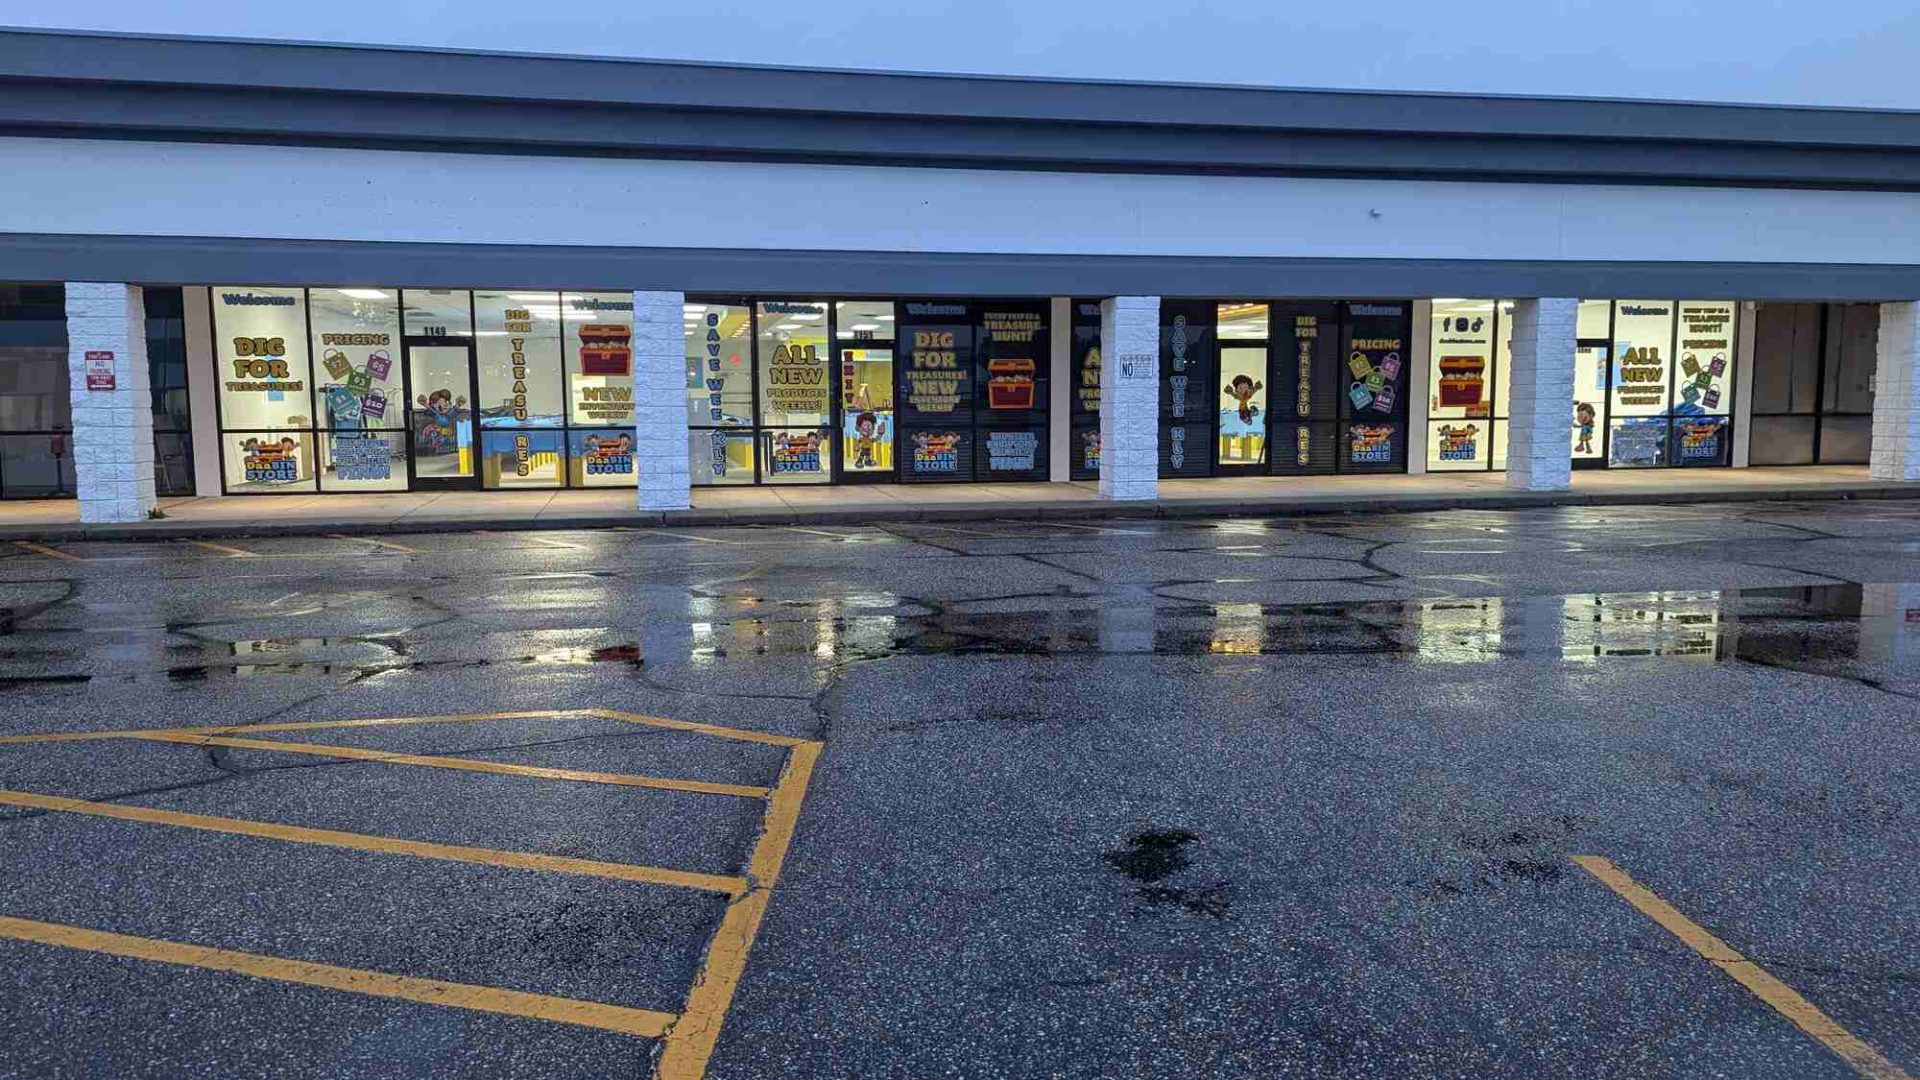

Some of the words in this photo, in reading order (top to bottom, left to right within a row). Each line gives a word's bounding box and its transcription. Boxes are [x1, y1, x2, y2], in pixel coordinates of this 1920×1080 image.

[222, 293, 295, 306] Welcome
[764, 301, 824, 314] Welcome
[1620, 305, 1669, 316] Welcome
[505, 309, 530, 320] DIG
[424, 326, 446, 337] 1149
[505, 322, 531, 333] FOR
[983, 320, 1041, 330] TREASURE
[1296, 327, 1317, 338] FOR
[322, 333, 390, 346] PRICING
[706, 313, 721, 372] SAVE
[914, 332, 954, 348] DIG
[1351, 339, 1400, 350] PRICING
[234, 337, 285, 356] DIG
[772, 345, 821, 366] ALL
[913, 351, 956, 369] FOR
[1623, 347, 1662, 365] ALL
[233, 359, 289, 379] FOR
[1122, 362, 1133, 376] NO
[1620, 367, 1663, 382] NEW
[769, 367, 823, 385] NEW
[582, 386, 632, 401] NEW
[767, 388, 827, 398] PRODUCTS
[912, 381, 958, 395] NEW
[1352, 451, 1390, 461] STORE
[1440, 450, 1476, 460] STORE
[587, 463, 633, 475] STORE
[776, 460, 820, 472] STORE
[914, 460, 958, 473] STORE
[245, 469, 297, 481] STORE
